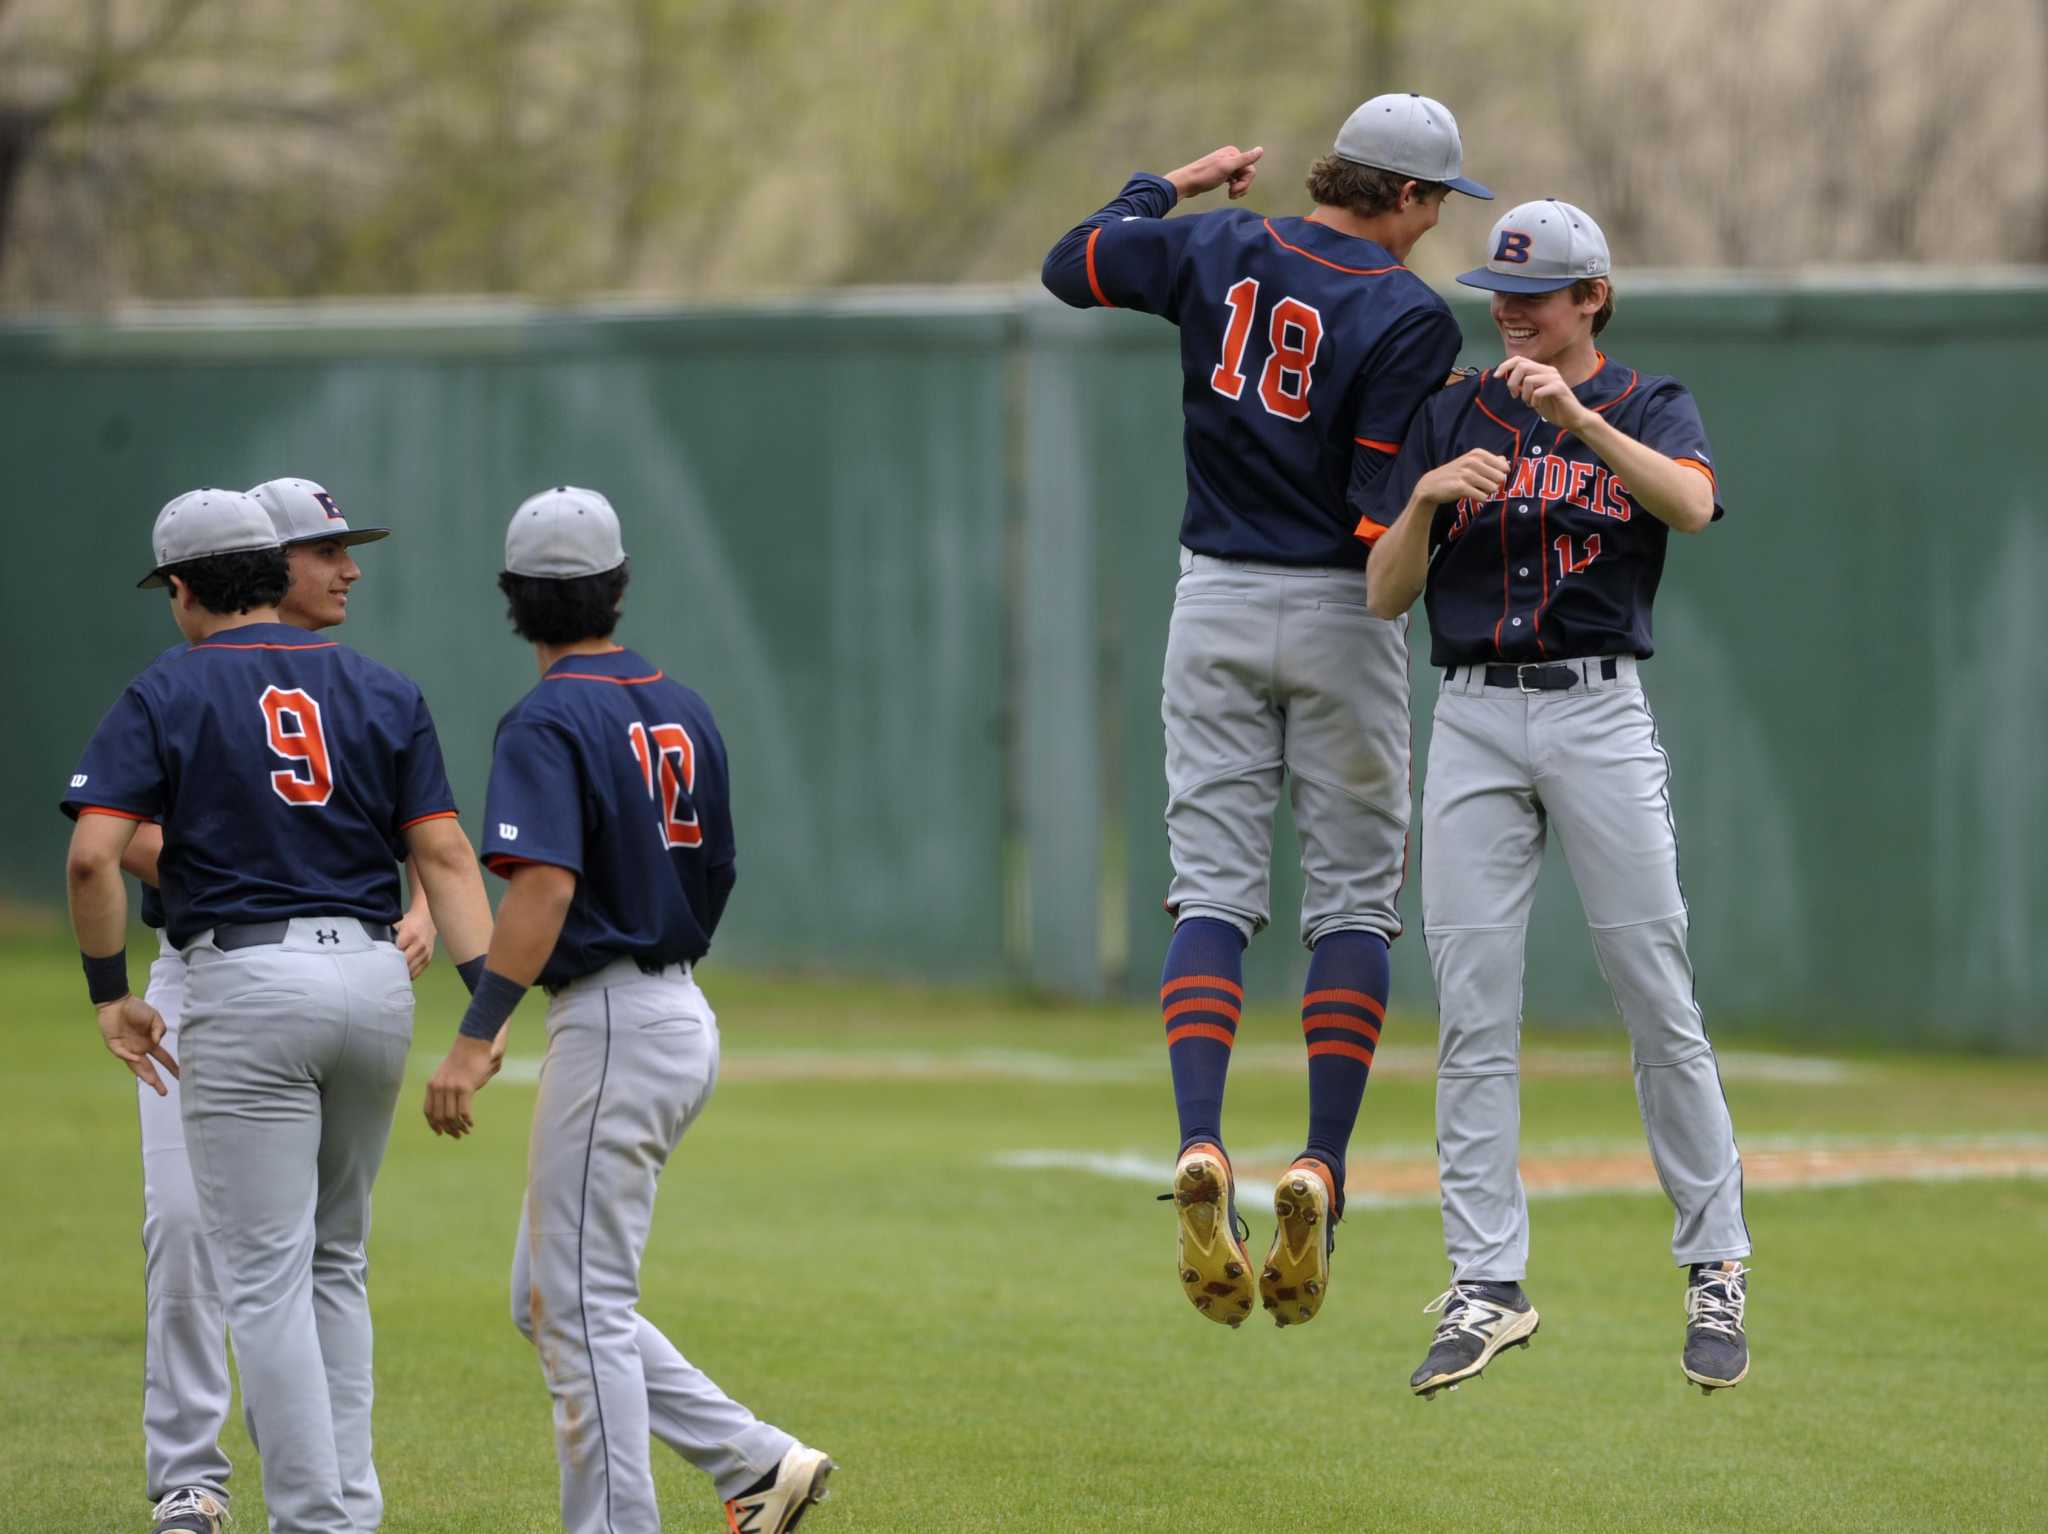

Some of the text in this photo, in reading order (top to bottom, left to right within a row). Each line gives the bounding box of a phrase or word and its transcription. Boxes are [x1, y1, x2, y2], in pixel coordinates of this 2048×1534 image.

[1493, 230, 1532, 264] B
[1211, 276, 1324, 422] 18
[258, 684, 334, 807] 9
